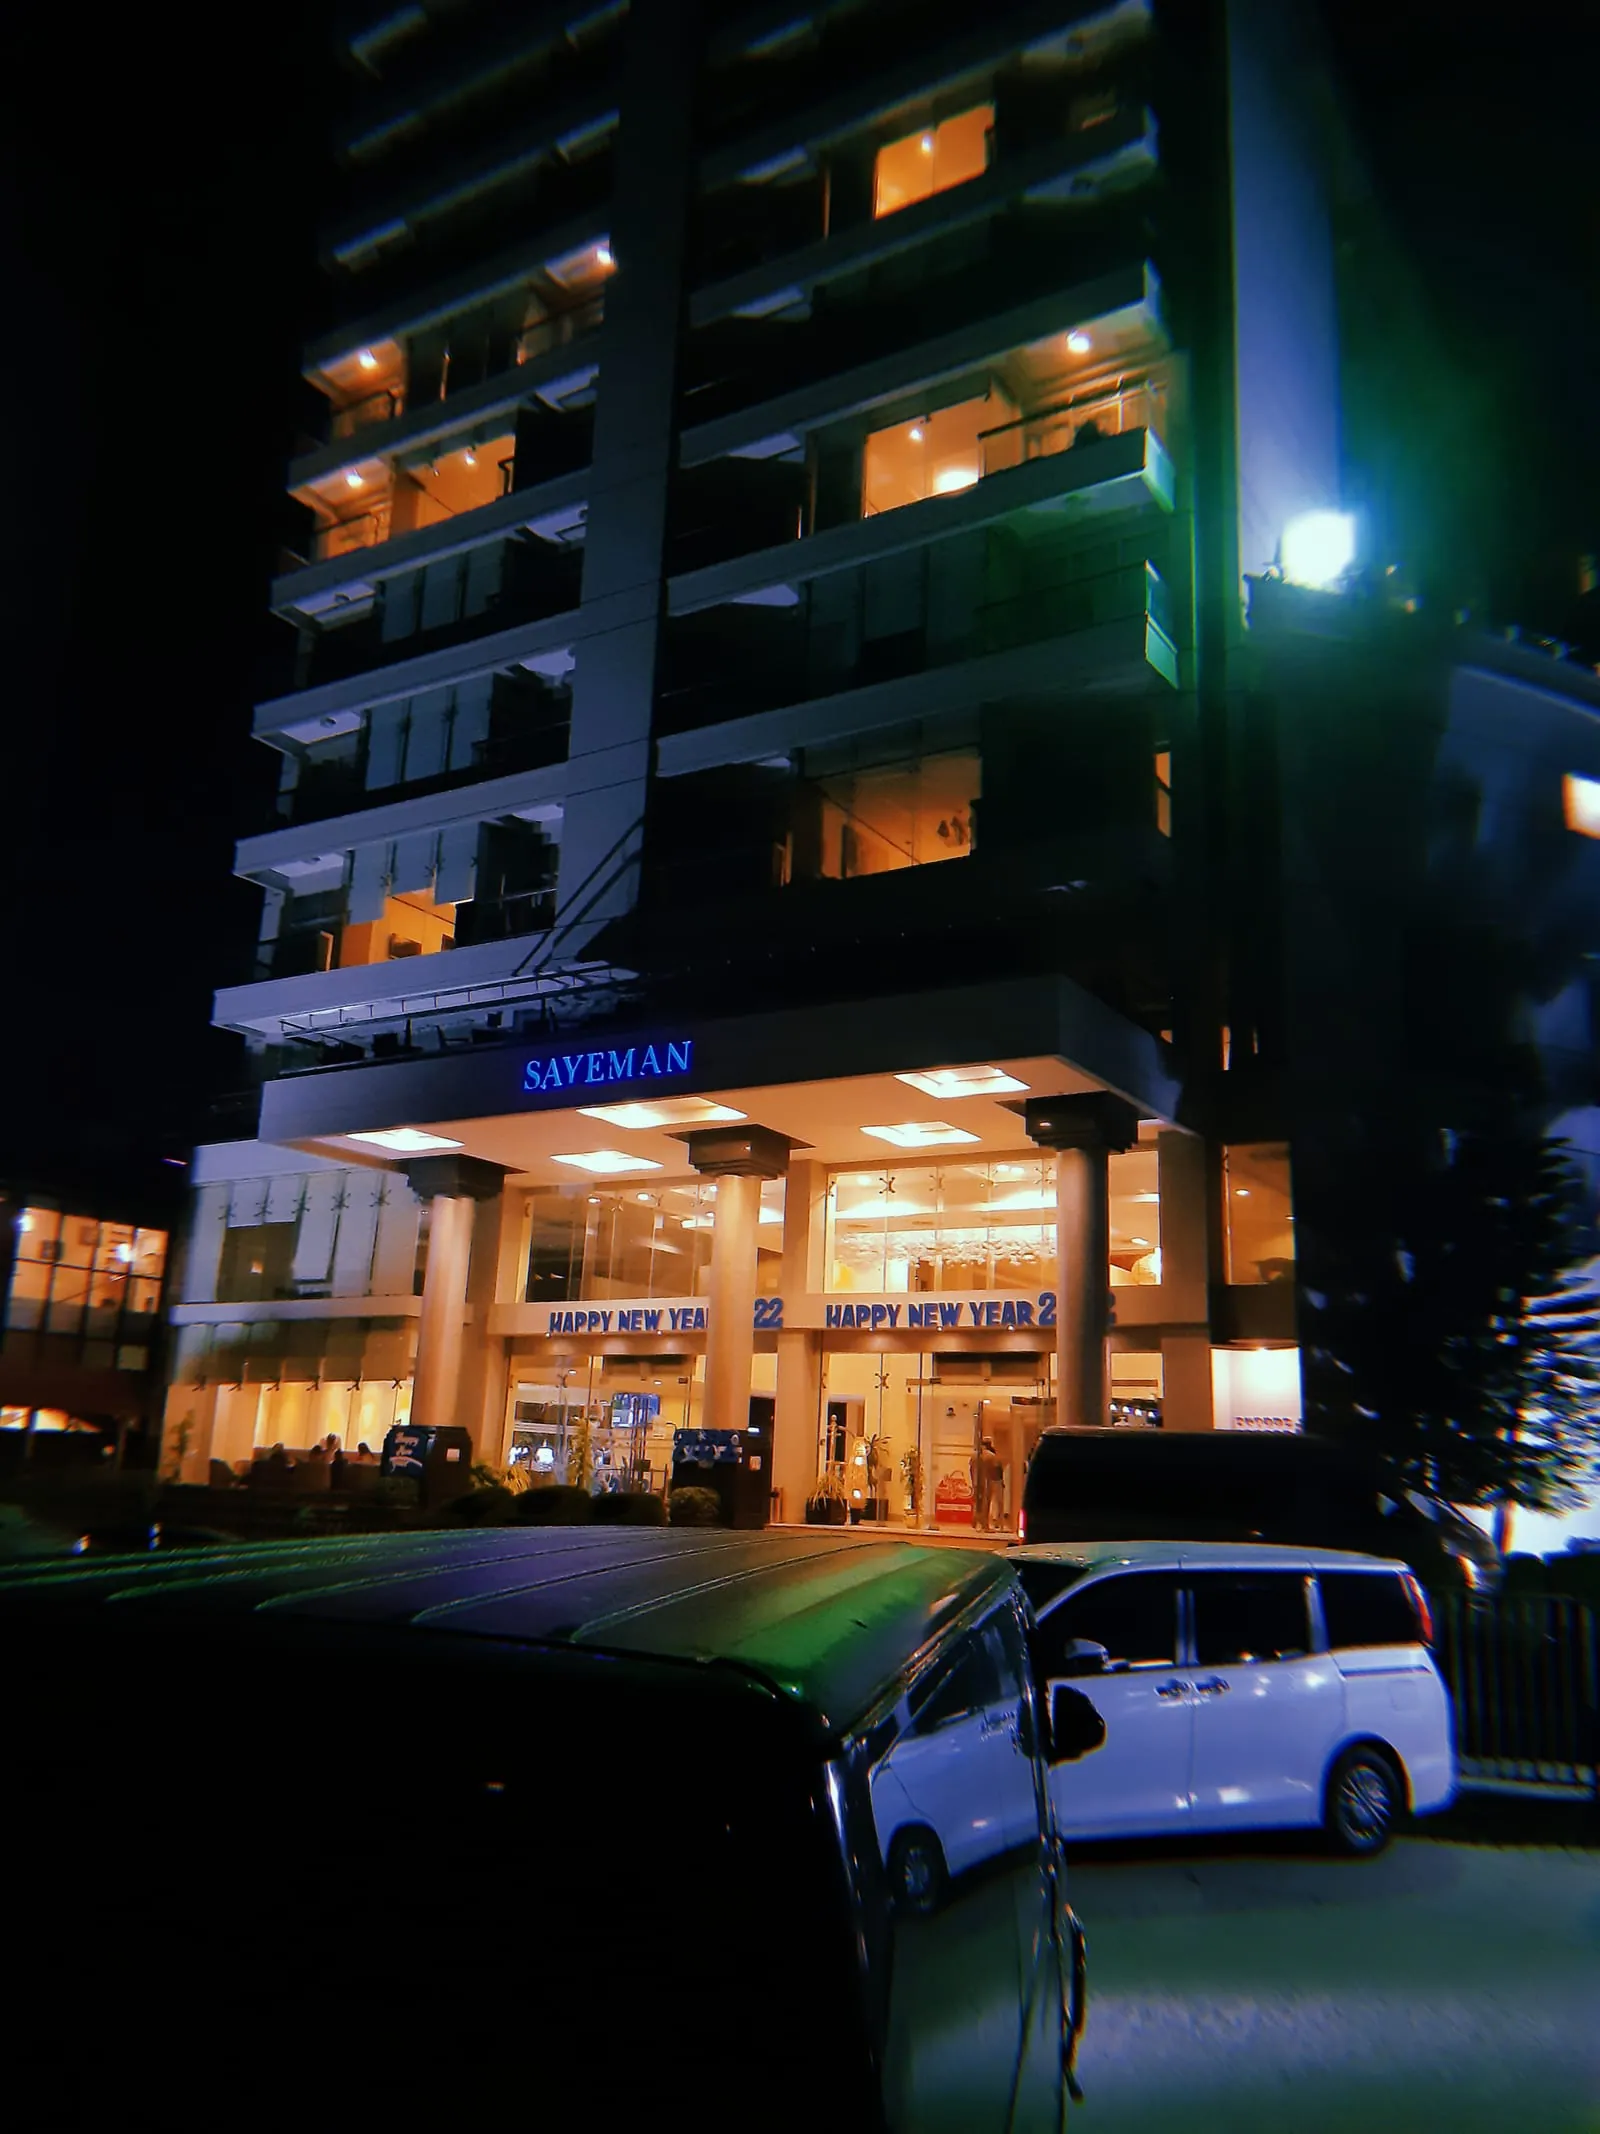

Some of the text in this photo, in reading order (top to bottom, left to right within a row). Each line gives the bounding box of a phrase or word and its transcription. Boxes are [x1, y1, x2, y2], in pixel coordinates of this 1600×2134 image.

[524, 1041, 691, 1090] SAYEMAN
[549, 1297, 784, 1333] HAPPY NEW YEA 22
[826, 1303, 902, 1328] HAPPY
[908, 1301, 964, 1328] NEW
[969, 1300, 1034, 1327] YEAR
